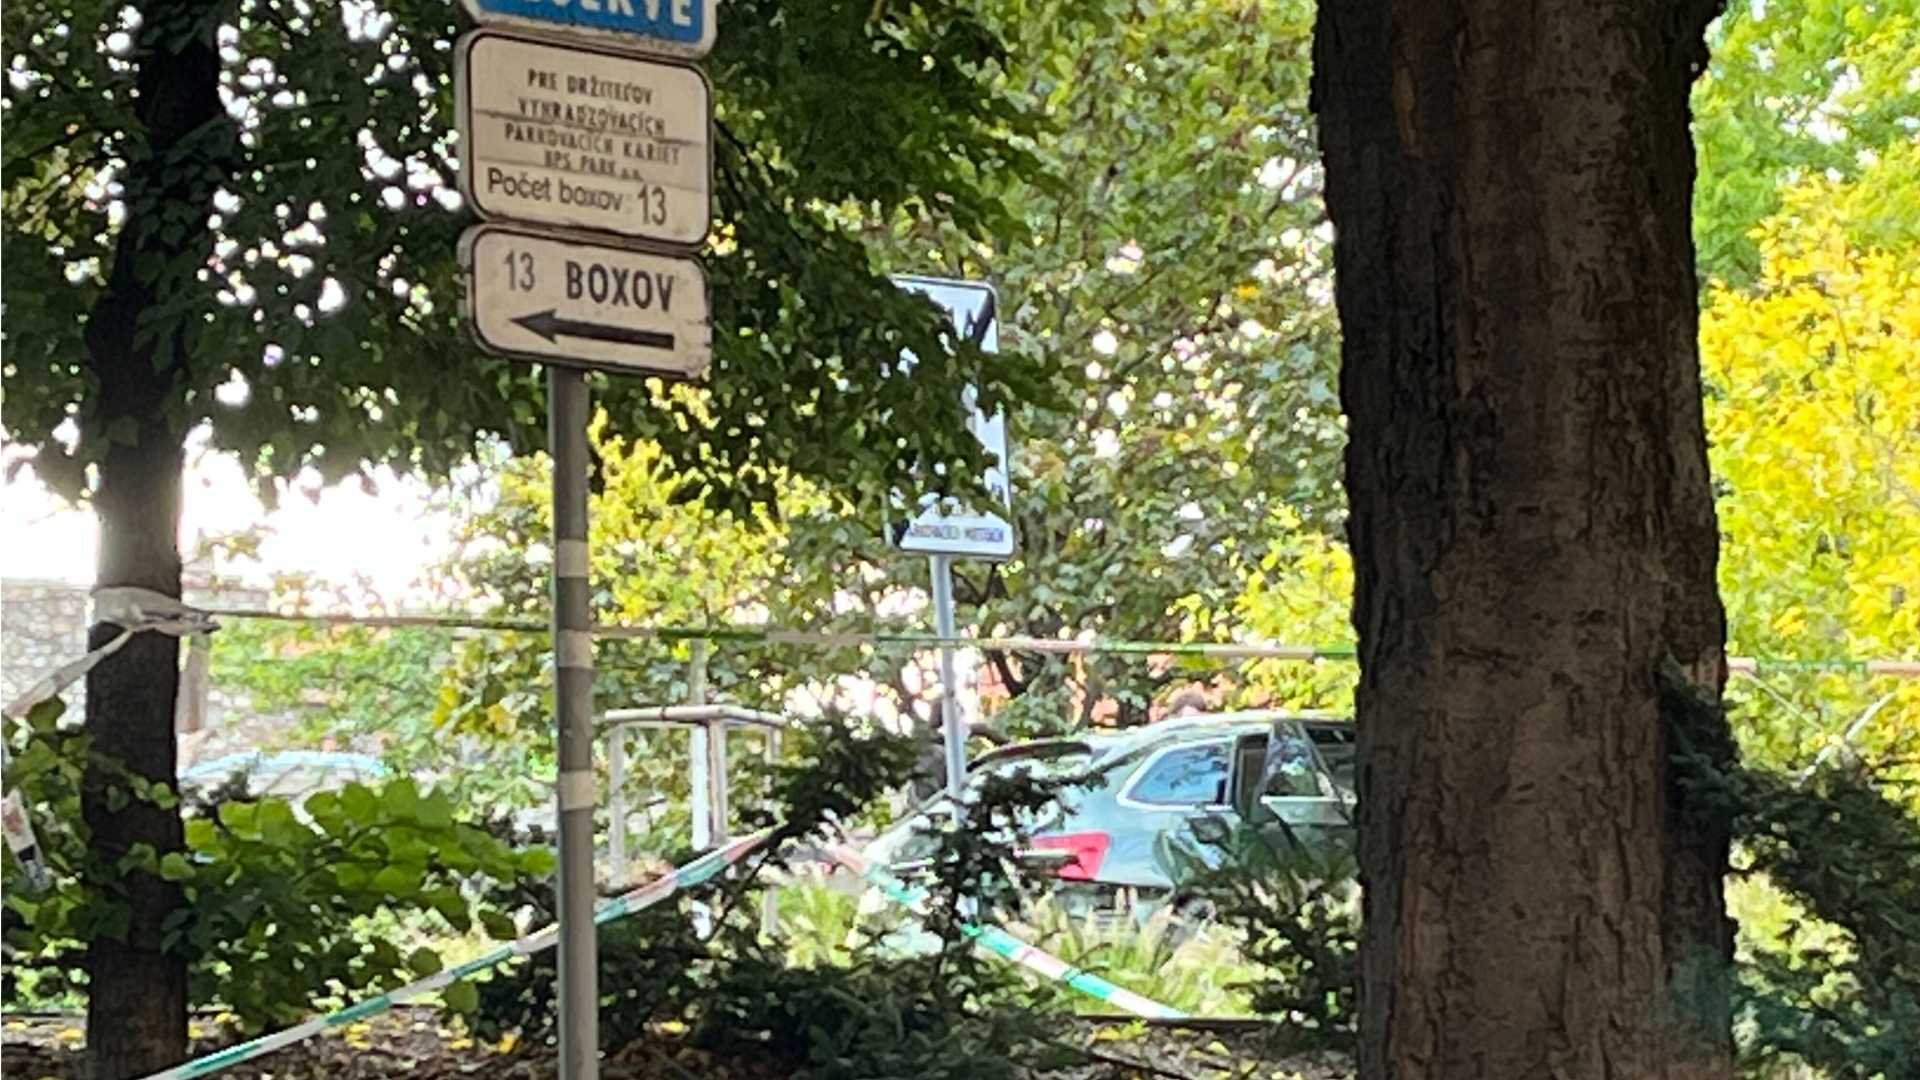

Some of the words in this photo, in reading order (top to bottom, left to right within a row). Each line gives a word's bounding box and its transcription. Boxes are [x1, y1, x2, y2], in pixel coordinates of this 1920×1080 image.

[528, 68, 557, 90] PRE
[487, 167, 551, 202] Počet
[637, 184, 667, 227] 13
[504, 249, 535, 292] 13
[566, 260, 674, 312] BOXOV
